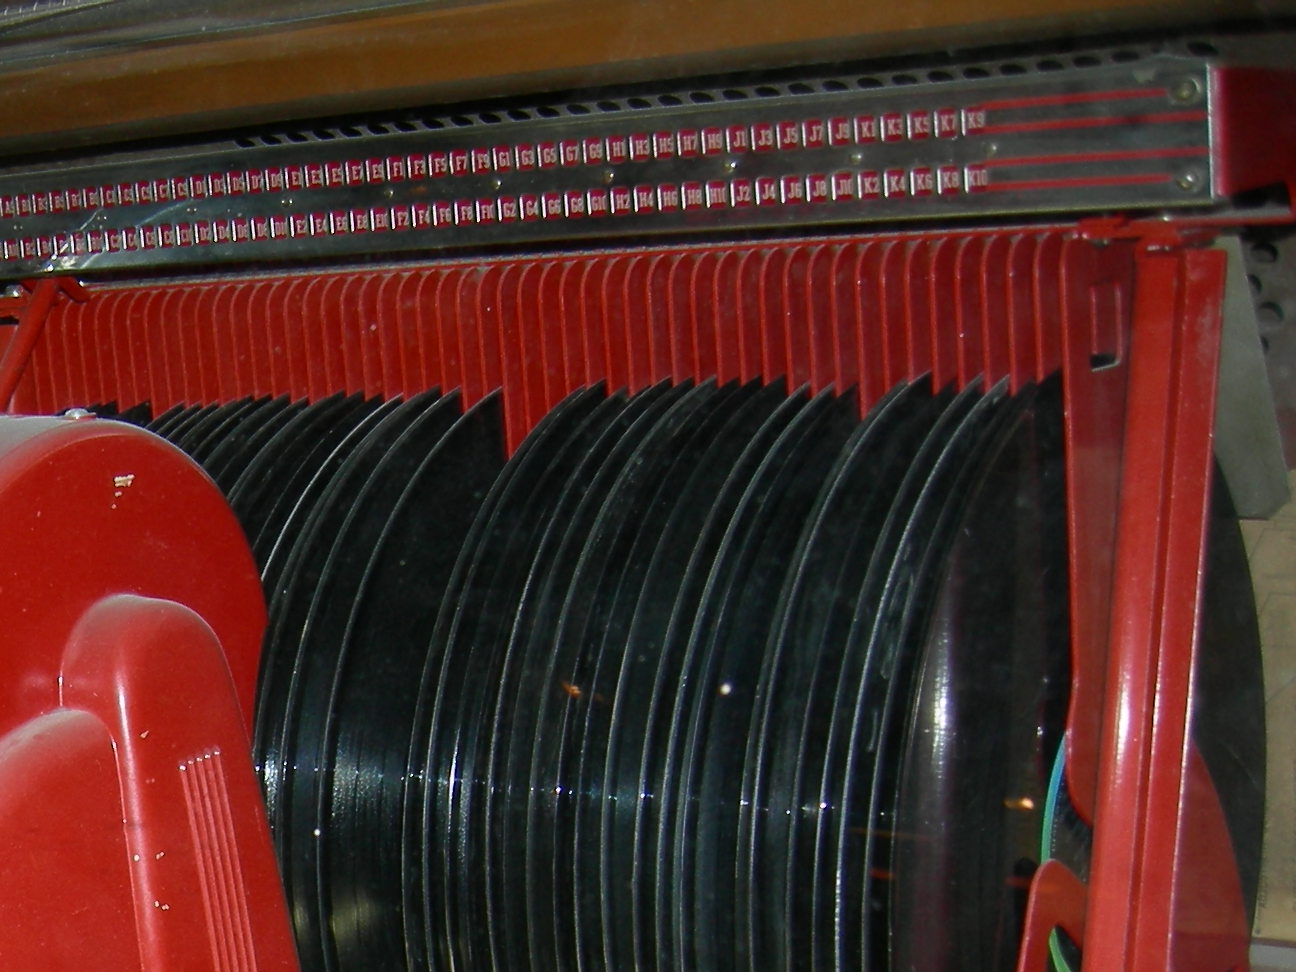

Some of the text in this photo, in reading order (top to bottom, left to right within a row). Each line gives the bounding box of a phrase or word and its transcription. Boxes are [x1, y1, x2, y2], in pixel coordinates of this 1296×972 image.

[733, 131, 746, 147] J1
[758, 129, 773, 145] J3
[809, 125, 823, 141] J7
[861, 121, 876, 137] K1
[914, 116, 929, 133] K5
[736, 185, 751, 201] J2
[762, 183, 777, 199] J4
[864, 177, 880, 193] K2
